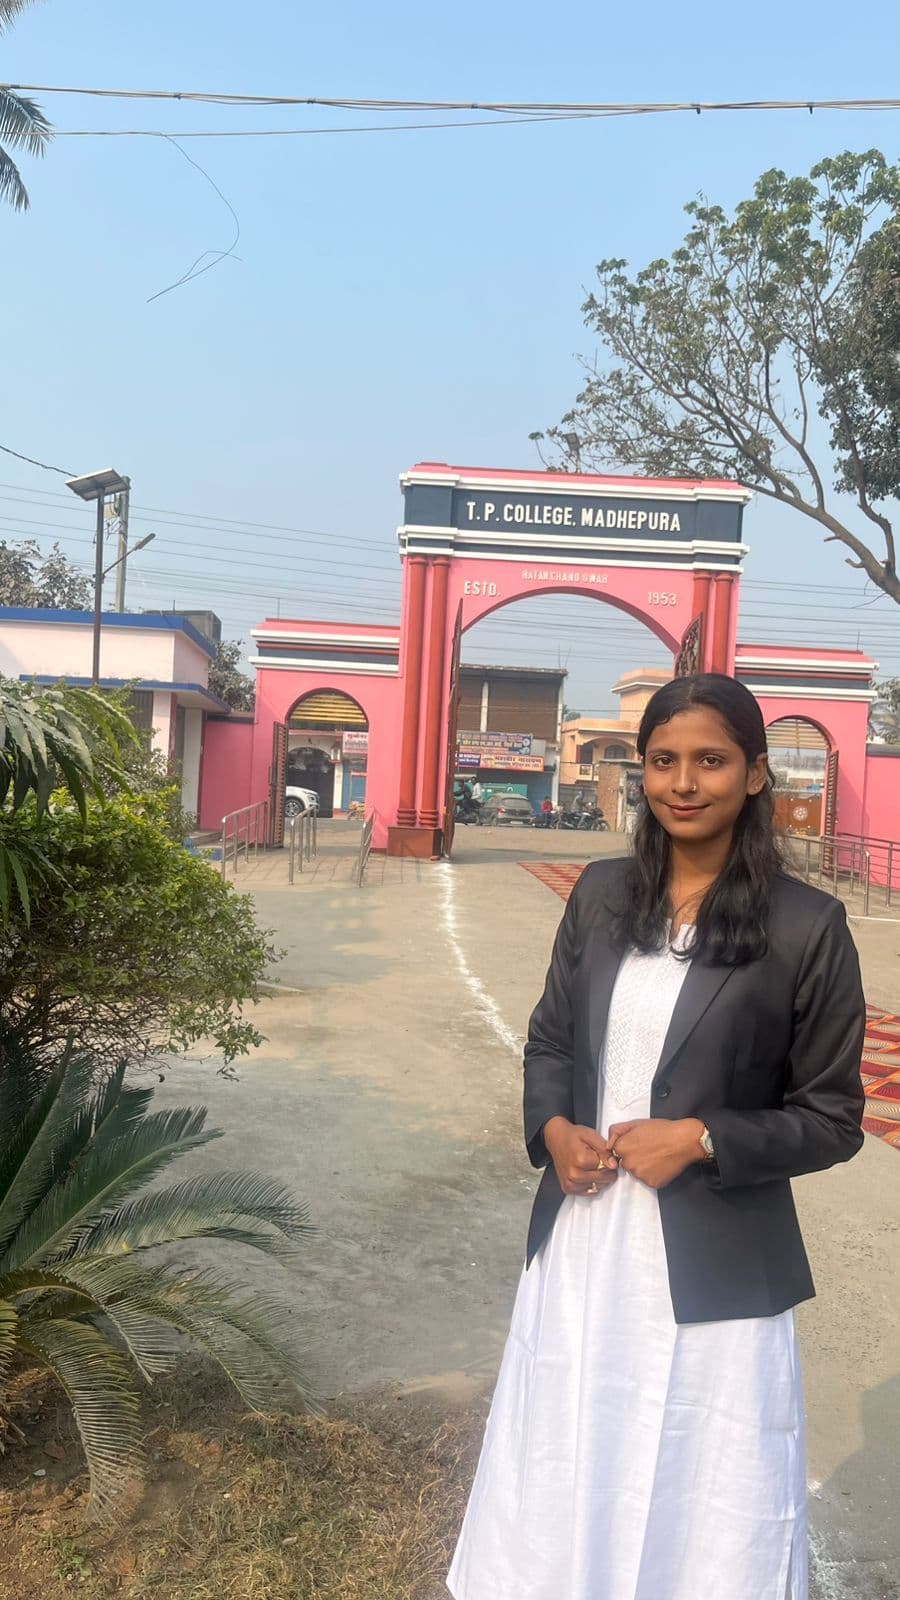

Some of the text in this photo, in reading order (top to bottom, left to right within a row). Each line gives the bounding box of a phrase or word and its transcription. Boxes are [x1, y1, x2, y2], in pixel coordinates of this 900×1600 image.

[467, 501, 480, 520] T.
[484, 502, 500, 521] P.
[581, 508, 681, 532] MADHEPURA
[648, 592, 677, 606] 1953
